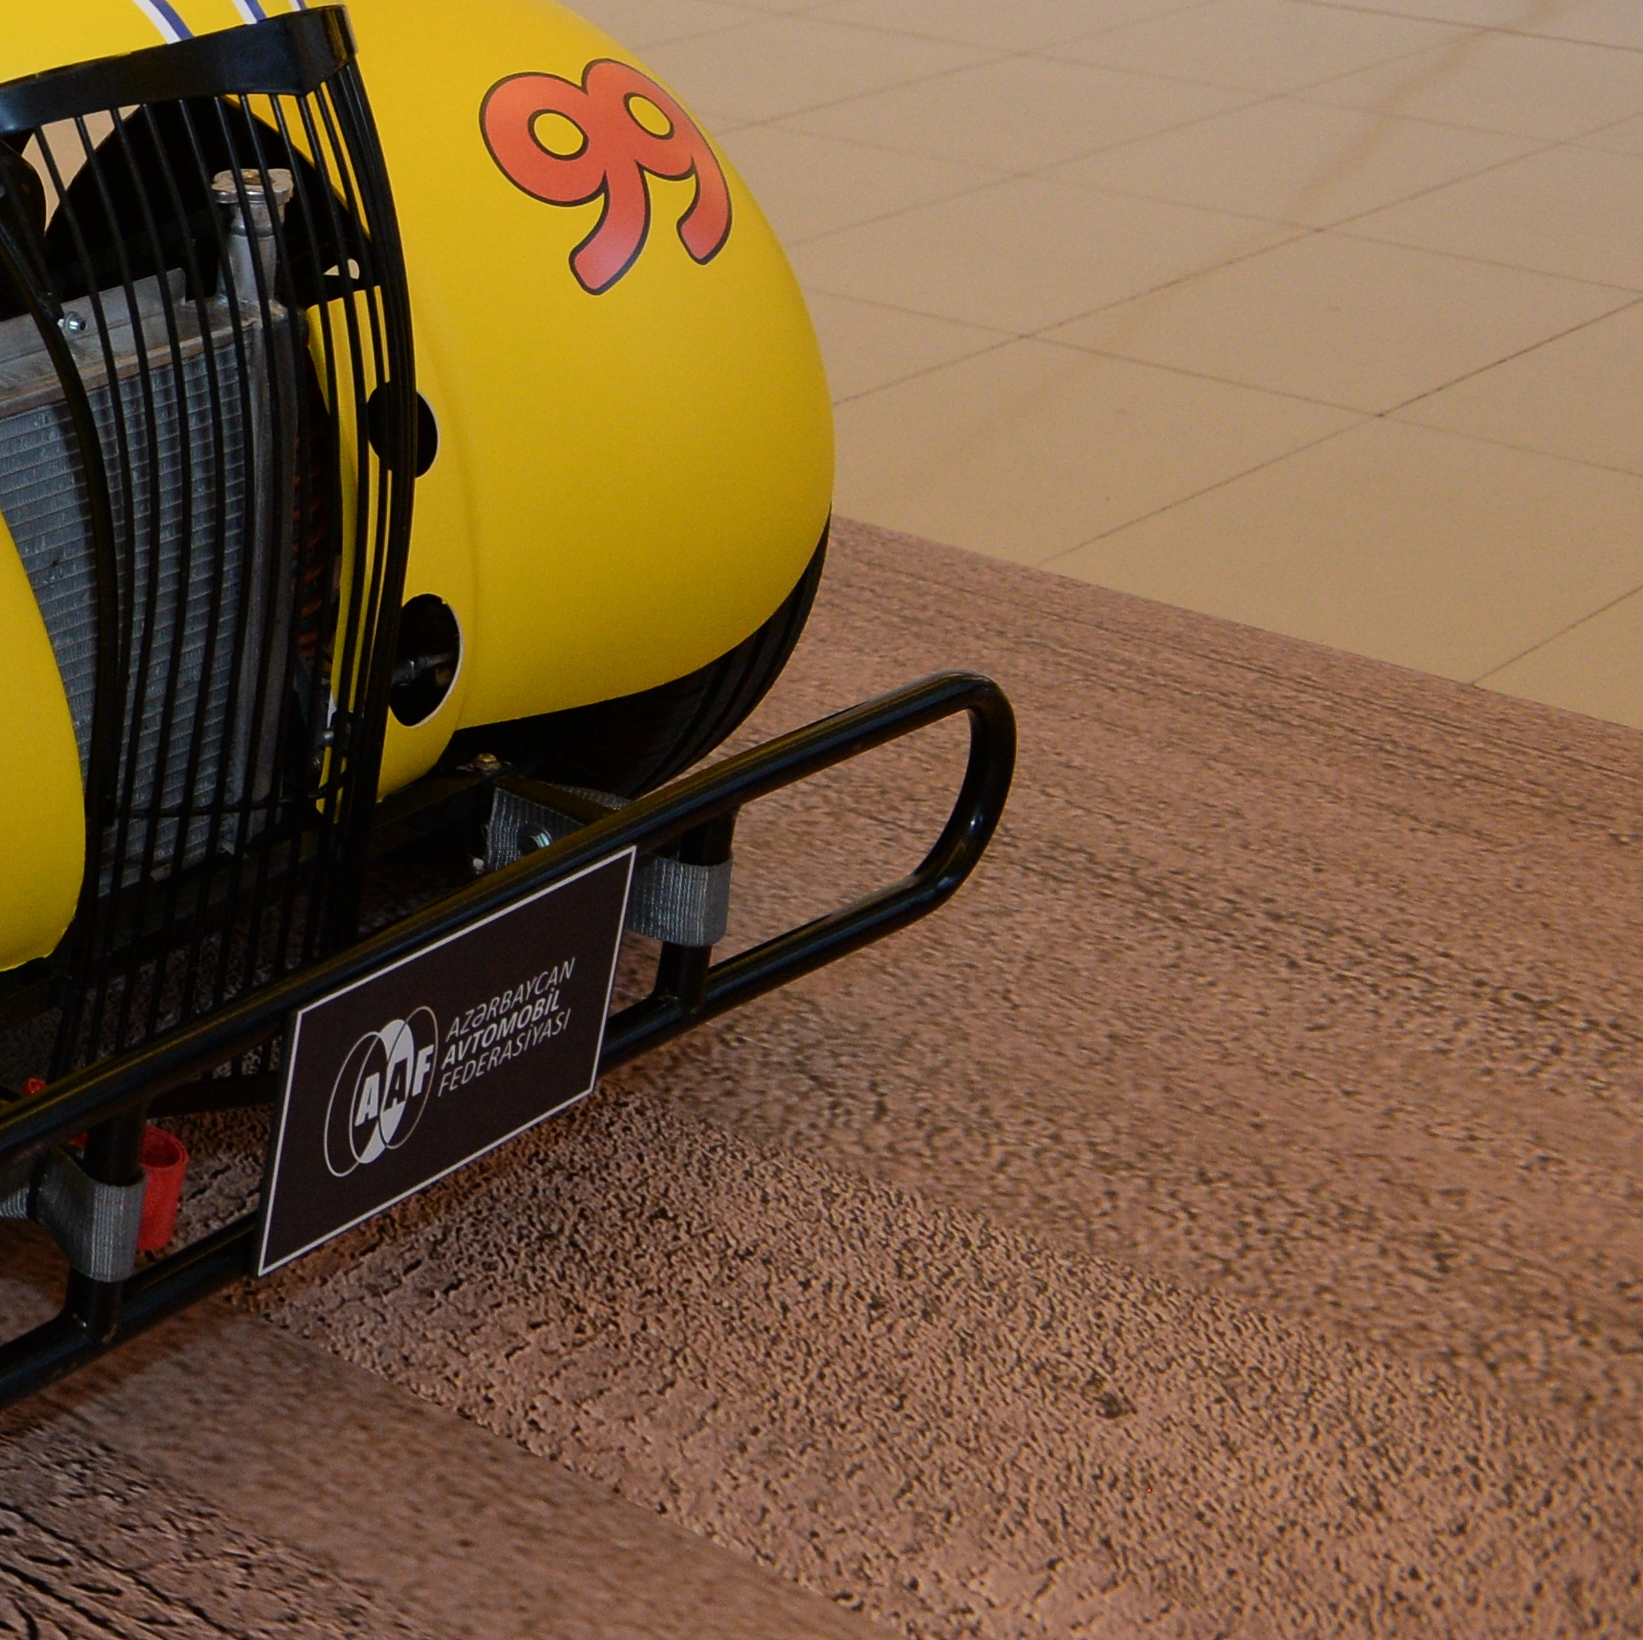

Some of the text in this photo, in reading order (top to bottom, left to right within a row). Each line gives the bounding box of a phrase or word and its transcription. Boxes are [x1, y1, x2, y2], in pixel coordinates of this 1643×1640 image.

[479, 57, 733, 296] 99
[441, 985, 561, 1071] AVTOMOBİL
[445, 956, 576, 1041] AZƏRBAYCAN
[355, 1044, 435, 1127] AAF
[437, 1007, 573, 1098] FEDERASİYASI
